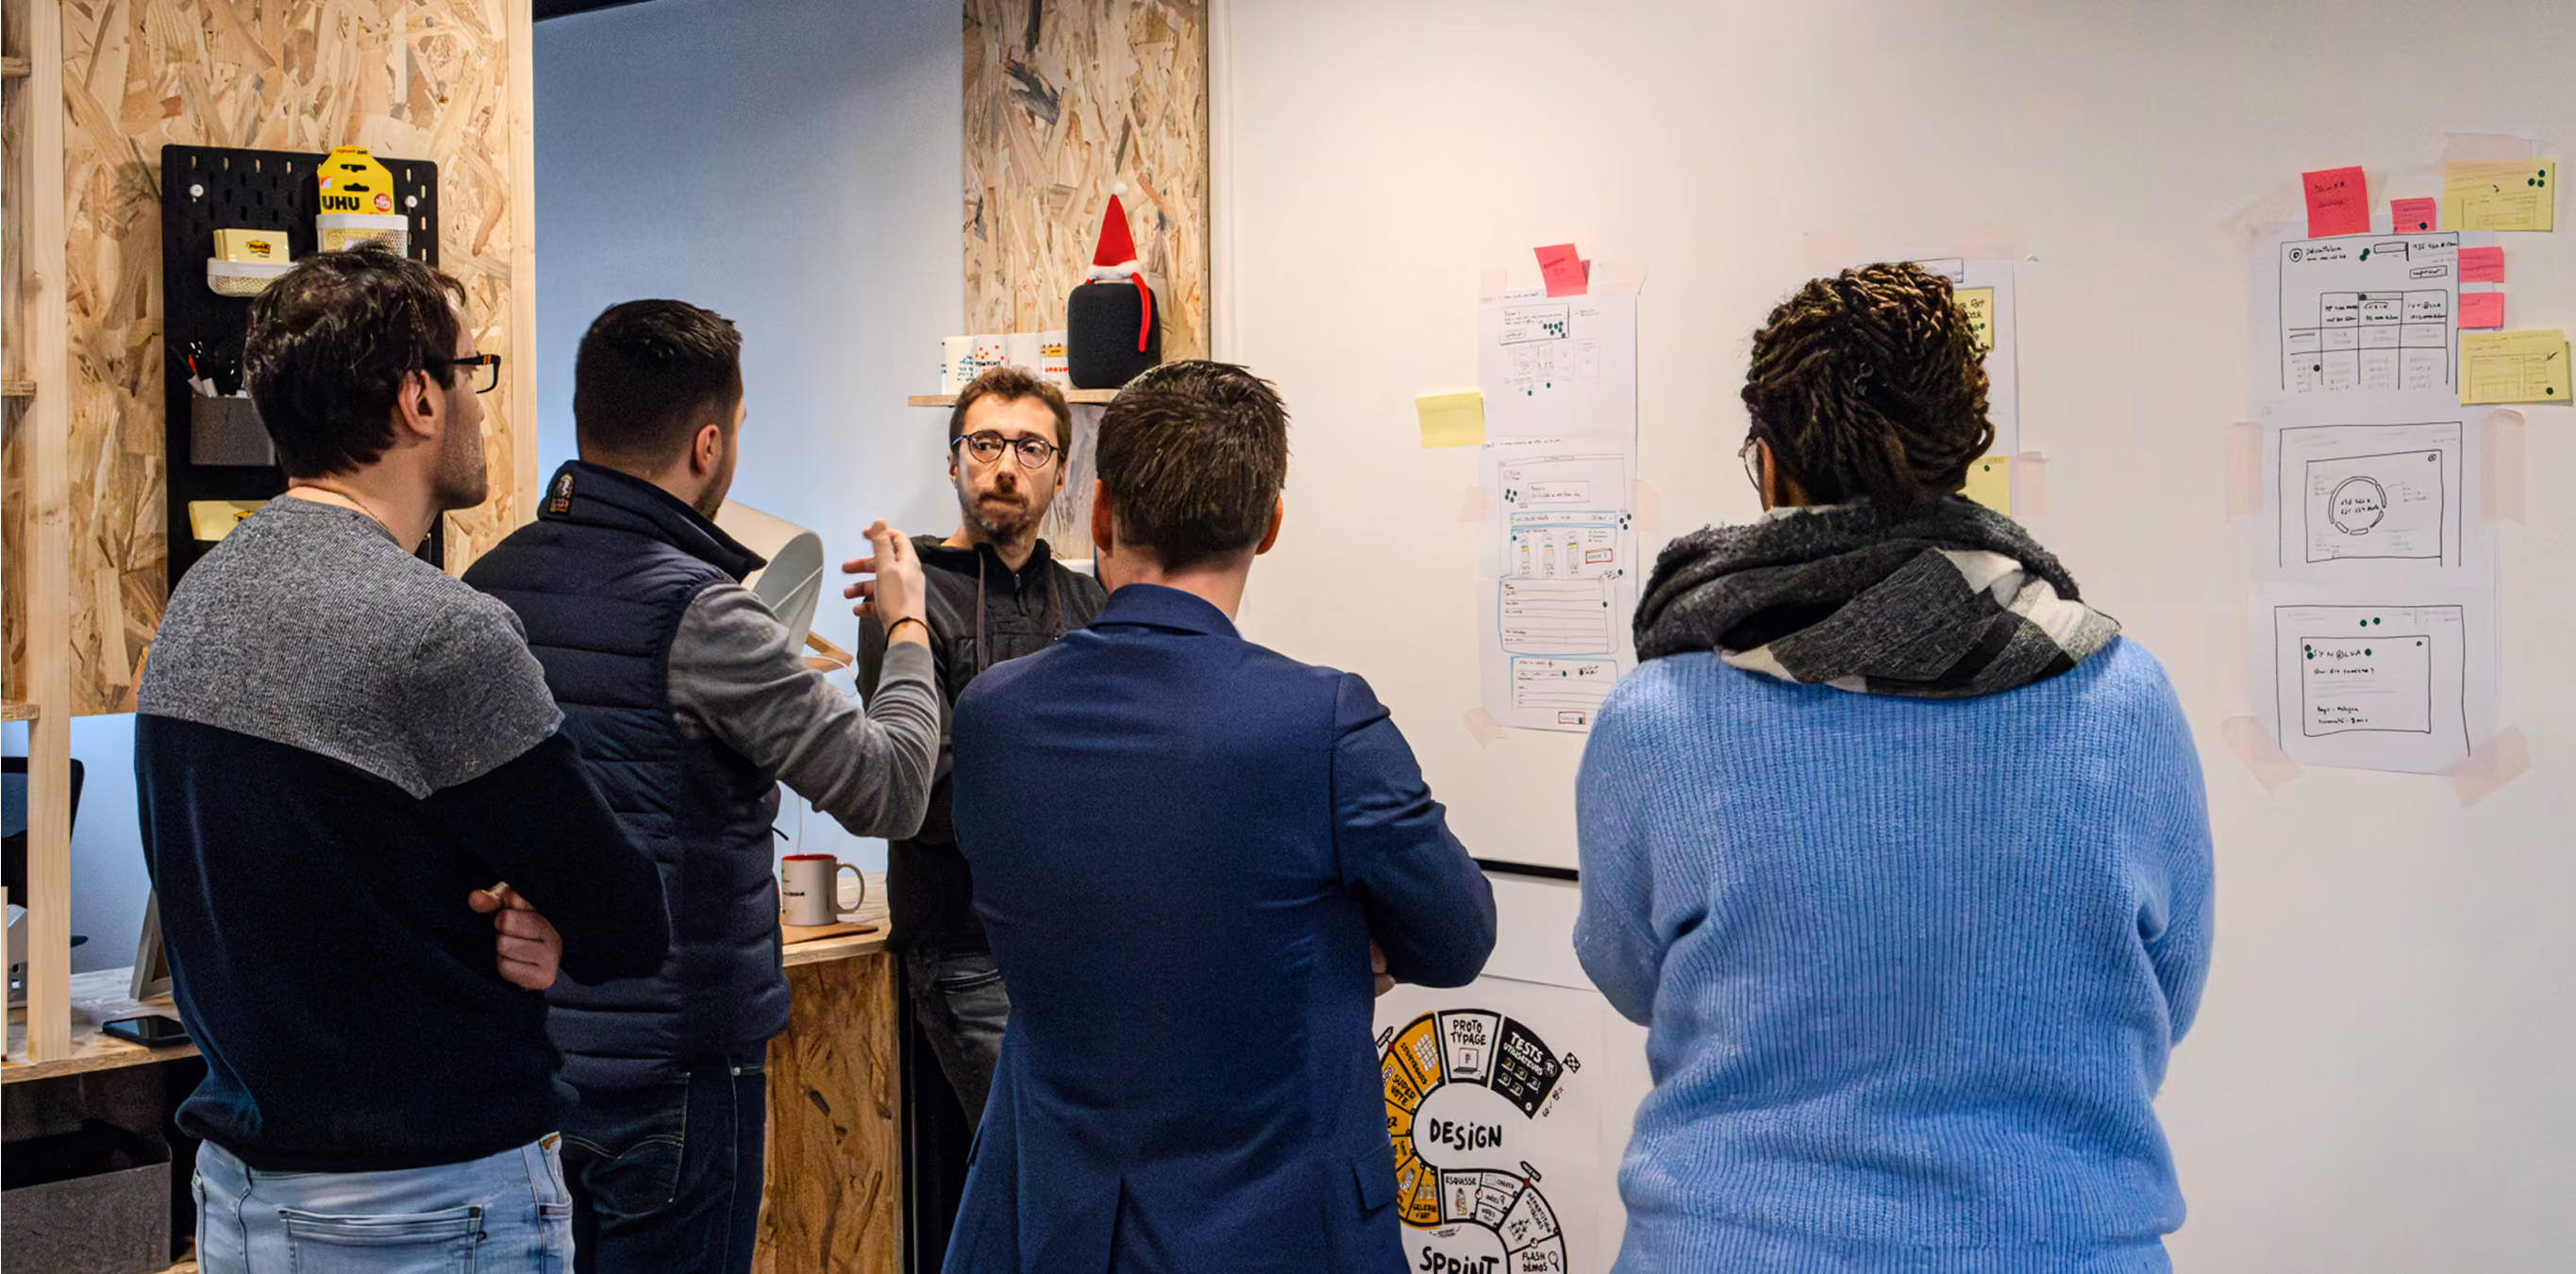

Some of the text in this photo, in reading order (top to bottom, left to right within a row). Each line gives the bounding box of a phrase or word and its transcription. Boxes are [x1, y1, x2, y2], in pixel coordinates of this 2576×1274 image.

[322, 195, 360, 210] UHU
[1453, 1019, 1482, 1033] PROTO
[1450, 1031, 1486, 1046] TYPAGE
[1511, 1031, 1543, 1063] TESTS
[1391, 1084, 1409, 1106] VOTE
[1522, 1251, 1546, 1261] FLASH
